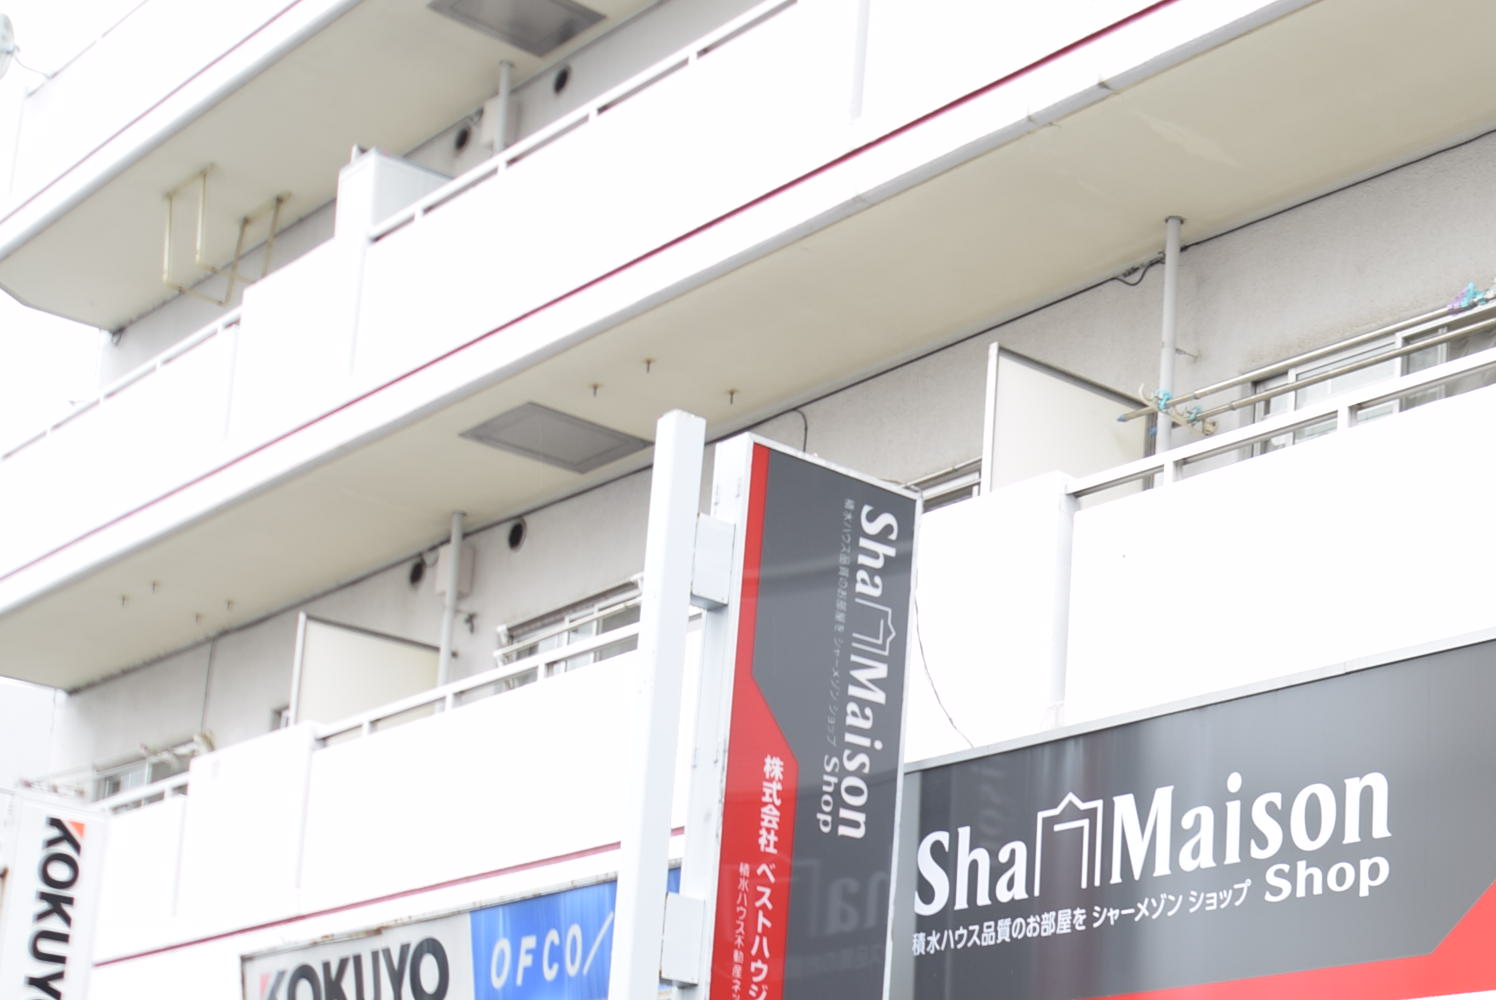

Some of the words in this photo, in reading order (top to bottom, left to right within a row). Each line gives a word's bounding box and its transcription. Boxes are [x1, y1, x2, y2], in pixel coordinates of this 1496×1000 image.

[855, 504, 898, 598] Sha
[816, 753, 840, 834] Shop
[837, 654, 888, 840] Maison
[757, 754, 785, 855] 株式会社
[914, 826, 1029, 916] Sha
[1109, 771, 1393, 886] Maison
[911, 907, 1087, 956] 積水ハウス品質のお部屋を
[1092, 894, 1184, 929] シャーメゾン
[1188, 878, 1253, 914] ショップ
[1264, 855, 1390, 902] Shop
